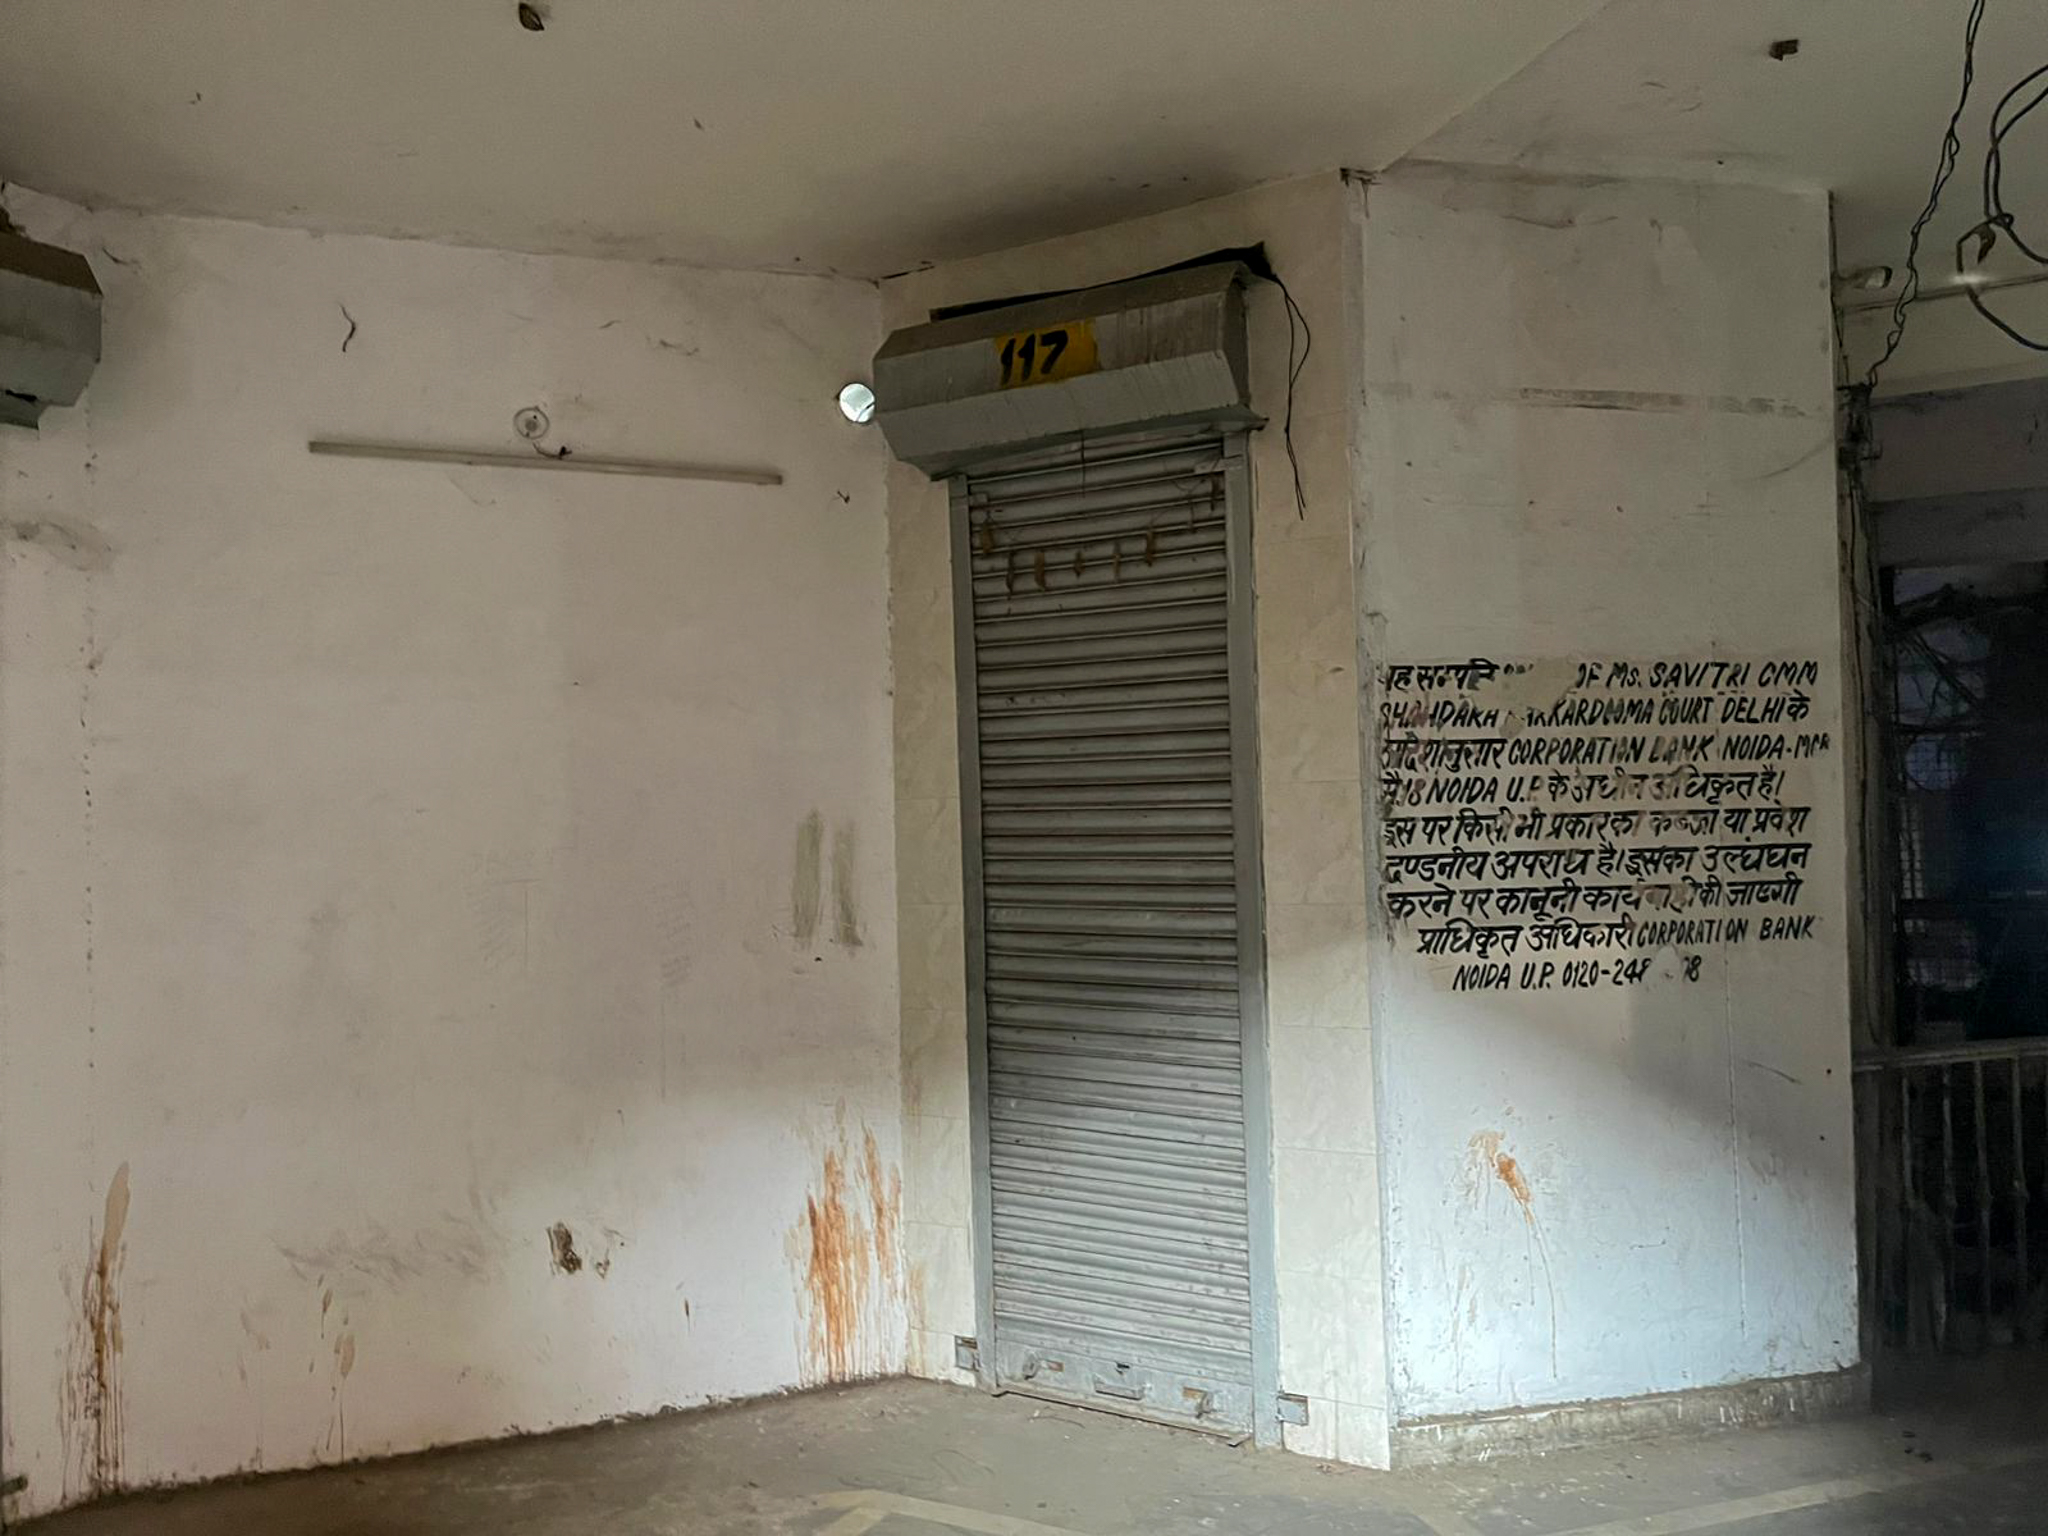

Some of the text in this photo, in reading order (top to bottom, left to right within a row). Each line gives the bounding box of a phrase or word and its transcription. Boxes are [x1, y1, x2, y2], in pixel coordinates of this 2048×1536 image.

[1001, 330, 1068, 383] 117
[1649, 661, 1750, 689] SAVITRI
[1758, 660, 1818, 687] CMM
[1658, 695, 1714, 725] COURT
[1720, 695, 1785, 724] DELHI
[1786, 688, 1810, 721] के
[1426, 776, 1498, 805] NOIDA
[1421, 815, 1453, 846] पर
[1724, 808, 1753, 833] या
[1386, 882, 1455, 921] करने
[1460, 888, 1494, 920] पर
[1636, 917, 1749, 949] CORPORATION
[1758, 914, 1817, 942] BANK
[1452, 962, 1511, 991] NOIDA
